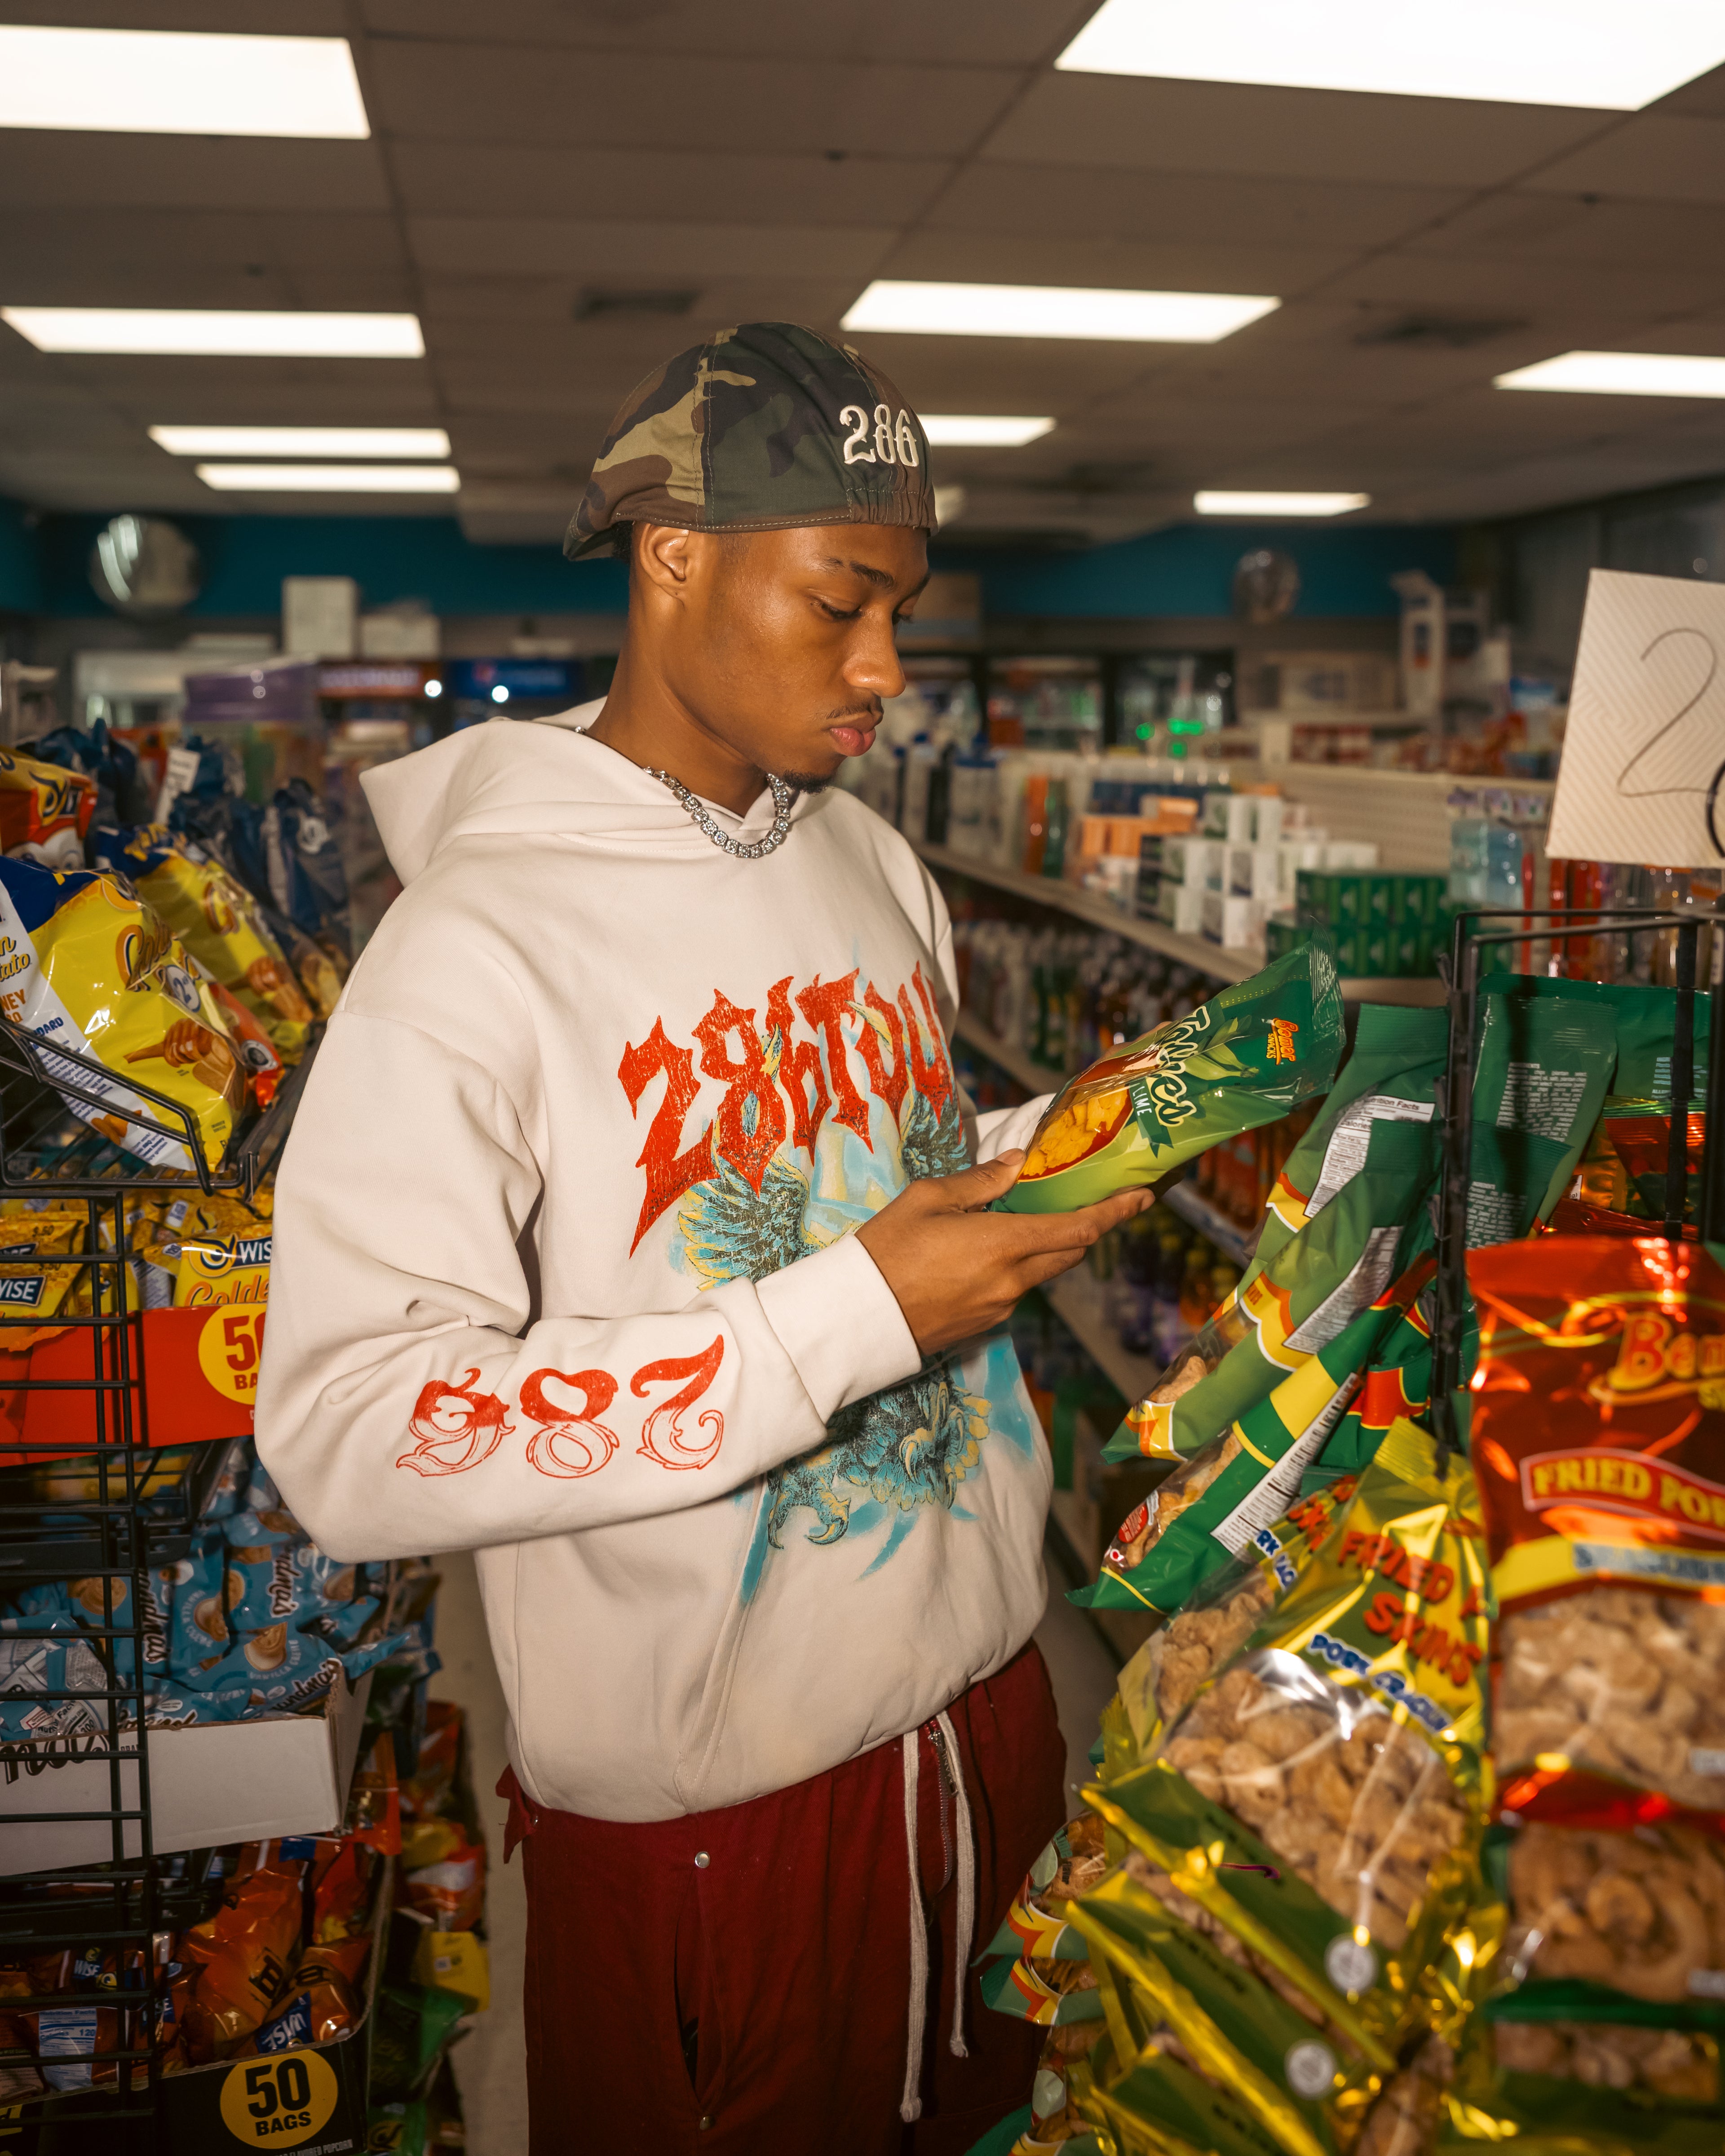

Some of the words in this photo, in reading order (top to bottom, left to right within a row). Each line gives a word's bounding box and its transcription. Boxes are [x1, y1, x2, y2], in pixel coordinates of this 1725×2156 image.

[839, 404, 920, 467] 286
[1266, 1033, 1277, 1059] SNACKS
[1275, 1018, 1300, 1062] Bemar
[1132, 1085, 1152, 1117] LIME
[1397, 1100, 1420, 1111] Facts
[1533, 1458, 1652, 1501] FRIED
[1337, 1530, 1455, 1604] FRIED
[1310, 1634, 1370, 1675] PORK
[74, 1959, 101, 1978] WISE
[245, 2058, 311, 2118] 50
[254, 2111, 312, 2137] BAGS
